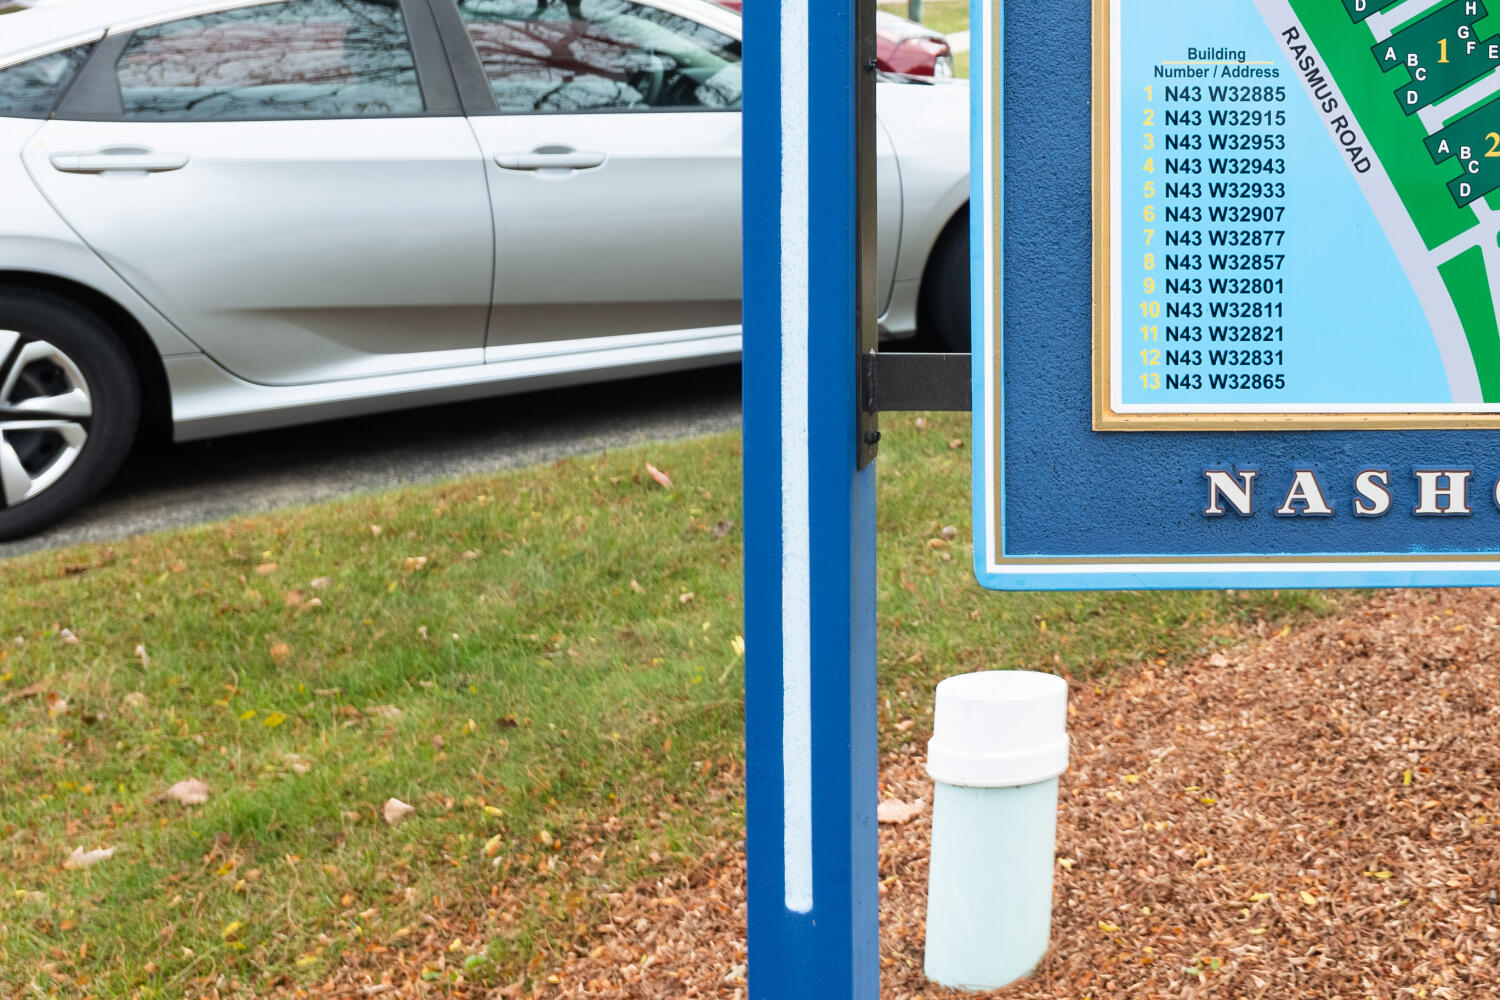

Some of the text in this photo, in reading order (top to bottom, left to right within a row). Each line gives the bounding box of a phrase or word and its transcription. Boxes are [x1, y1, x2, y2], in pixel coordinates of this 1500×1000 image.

[1465, 1, 1477, 16] H
[1457, 25, 1470, 39] G
[1187, 47, 1246, 64] Building
[1384, 46, 1397, 61] A
[1438, 38, 1449, 64] 1
[1466, 41, 1476, 55] F
[1488, 44, 1499, 59] E
[1407, 53, 1419, 67] B
[1154, 65, 1209, 78] Number
[1220, 65, 1280, 78] Address
[1415, 67, 1427, 81] C
[1144, 84, 1286, 102] 1 N43 W32885
[1281, 25, 1372, 174] RASMUS ROAD
[1407, 90, 1418, 105] D
[1143, 108, 1286, 127] 2 N43 W32915
[1143, 132, 1286, 151] 3 N43 W32953
[1437, 139, 1450, 154] A
[1484, 131, 1500, 158] 2
[1460, 146, 1472, 160] B
[1143, 157, 1286, 175] 4 N43 W32943
[1468, 160, 1480, 174] C
[1143, 181, 1286, 199] 5 N43 W32933
[1460, 182, 1471, 197] D
[1143, 205, 1286, 223] 6 N43 W32907
[1143, 229, 1286, 247] 7 N43 W32877
[1143, 253, 1286, 271] 8 N43 W32857
[1143, 277, 1283, 295] 9 N43 W32801
[1139, 300, 1283, 319] 10 N43 W32811
[1140, 324, 1283, 342] 11 N43 W32821
[1139, 348, 1283, 366] 12 N43 W32831
[1139, 372, 1286, 390] 13 N43 W32865
